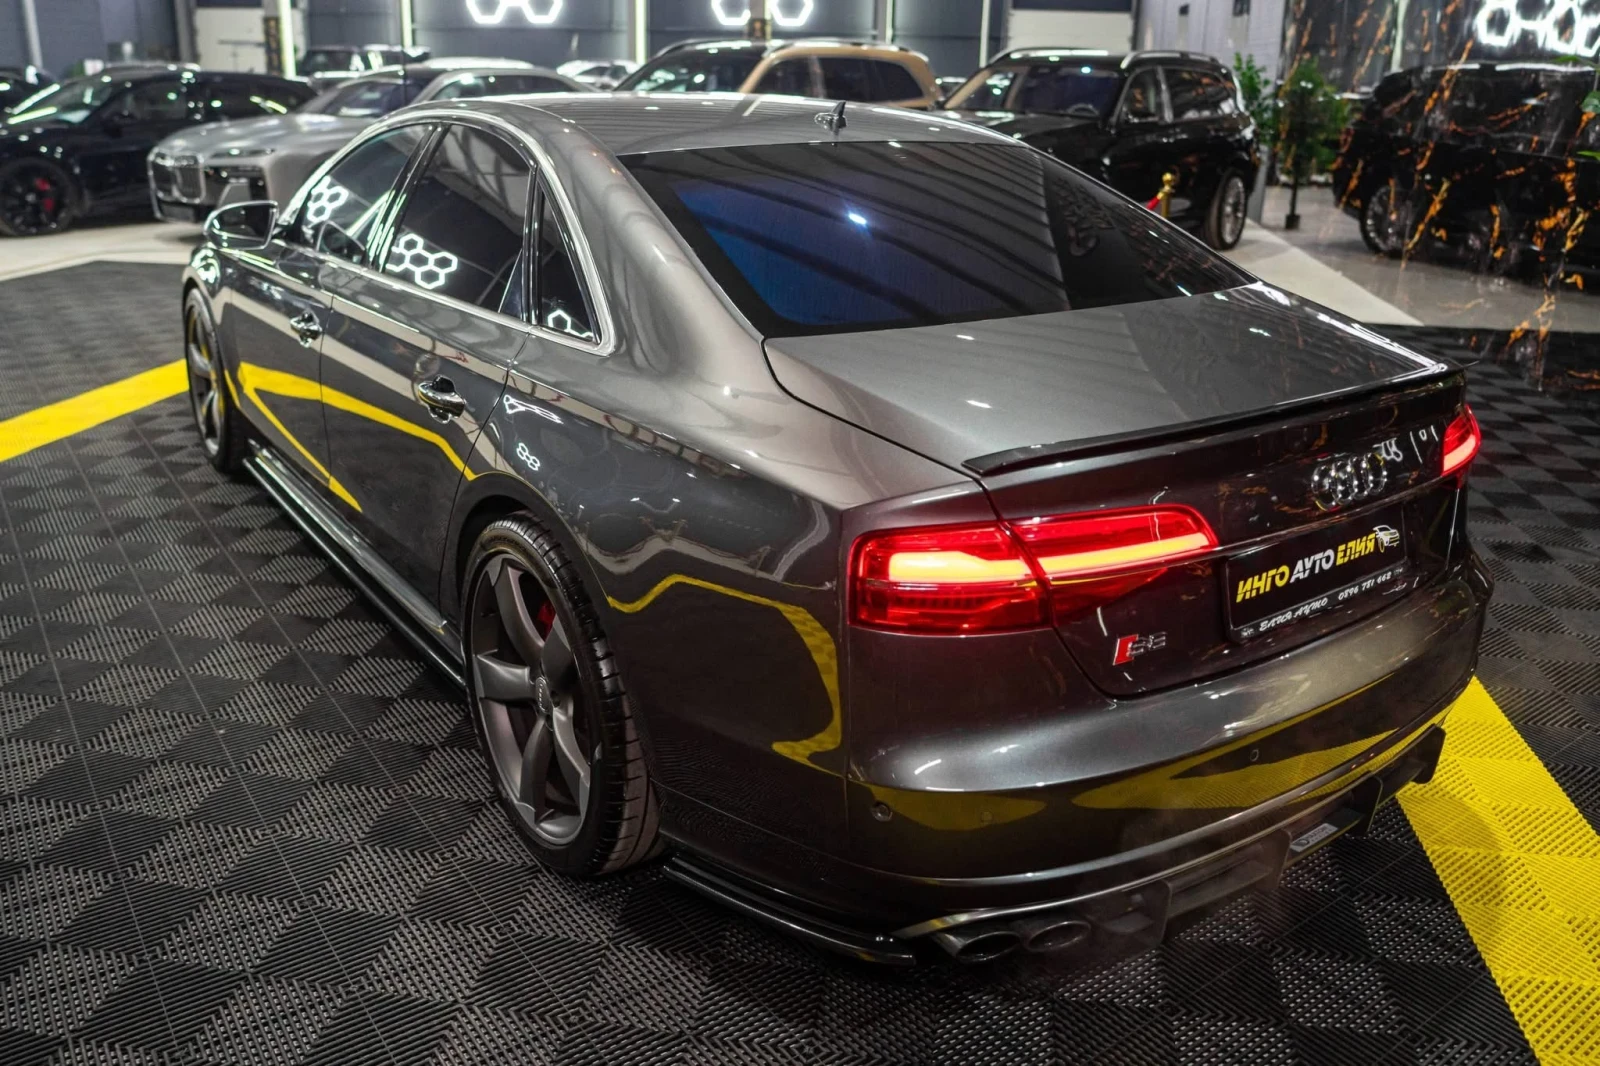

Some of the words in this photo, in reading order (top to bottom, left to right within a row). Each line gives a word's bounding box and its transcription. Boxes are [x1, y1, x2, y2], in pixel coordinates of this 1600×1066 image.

[1236, 565, 1290, 603] ИНГО
[1290, 549, 1335, 583] АУТО
[1336, 532, 1376, 566] ЕЛИЯ
